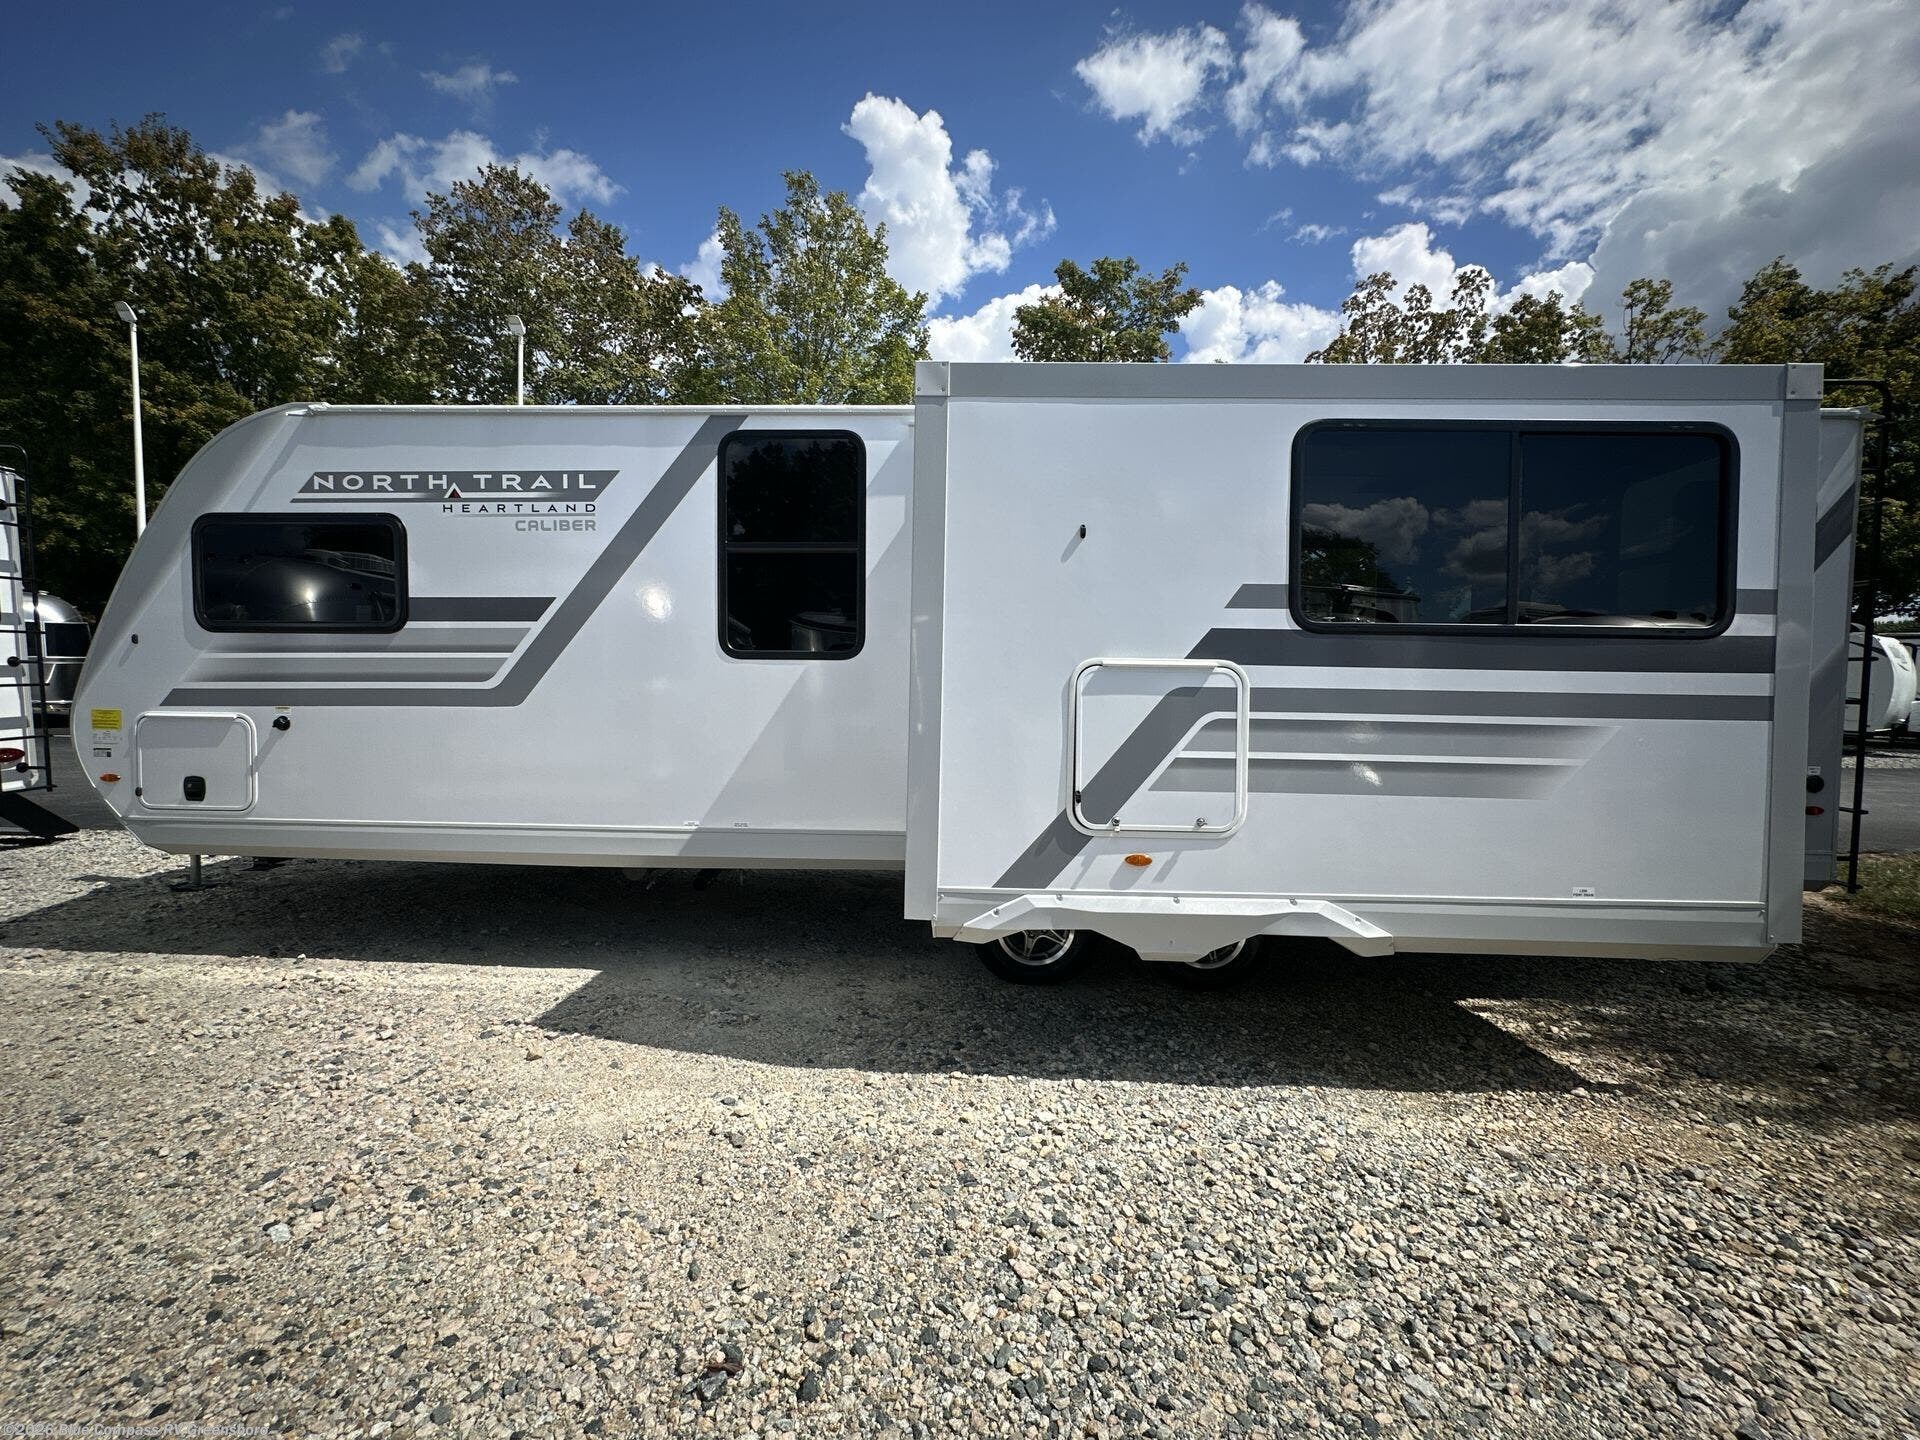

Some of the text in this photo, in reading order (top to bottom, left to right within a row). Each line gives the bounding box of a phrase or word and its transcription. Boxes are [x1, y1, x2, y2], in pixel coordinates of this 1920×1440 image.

[312, 473, 597, 491] NORTH TRAIL
[442, 503, 596, 514] HEARTLAND
[514, 519, 597, 532] CALIBER
